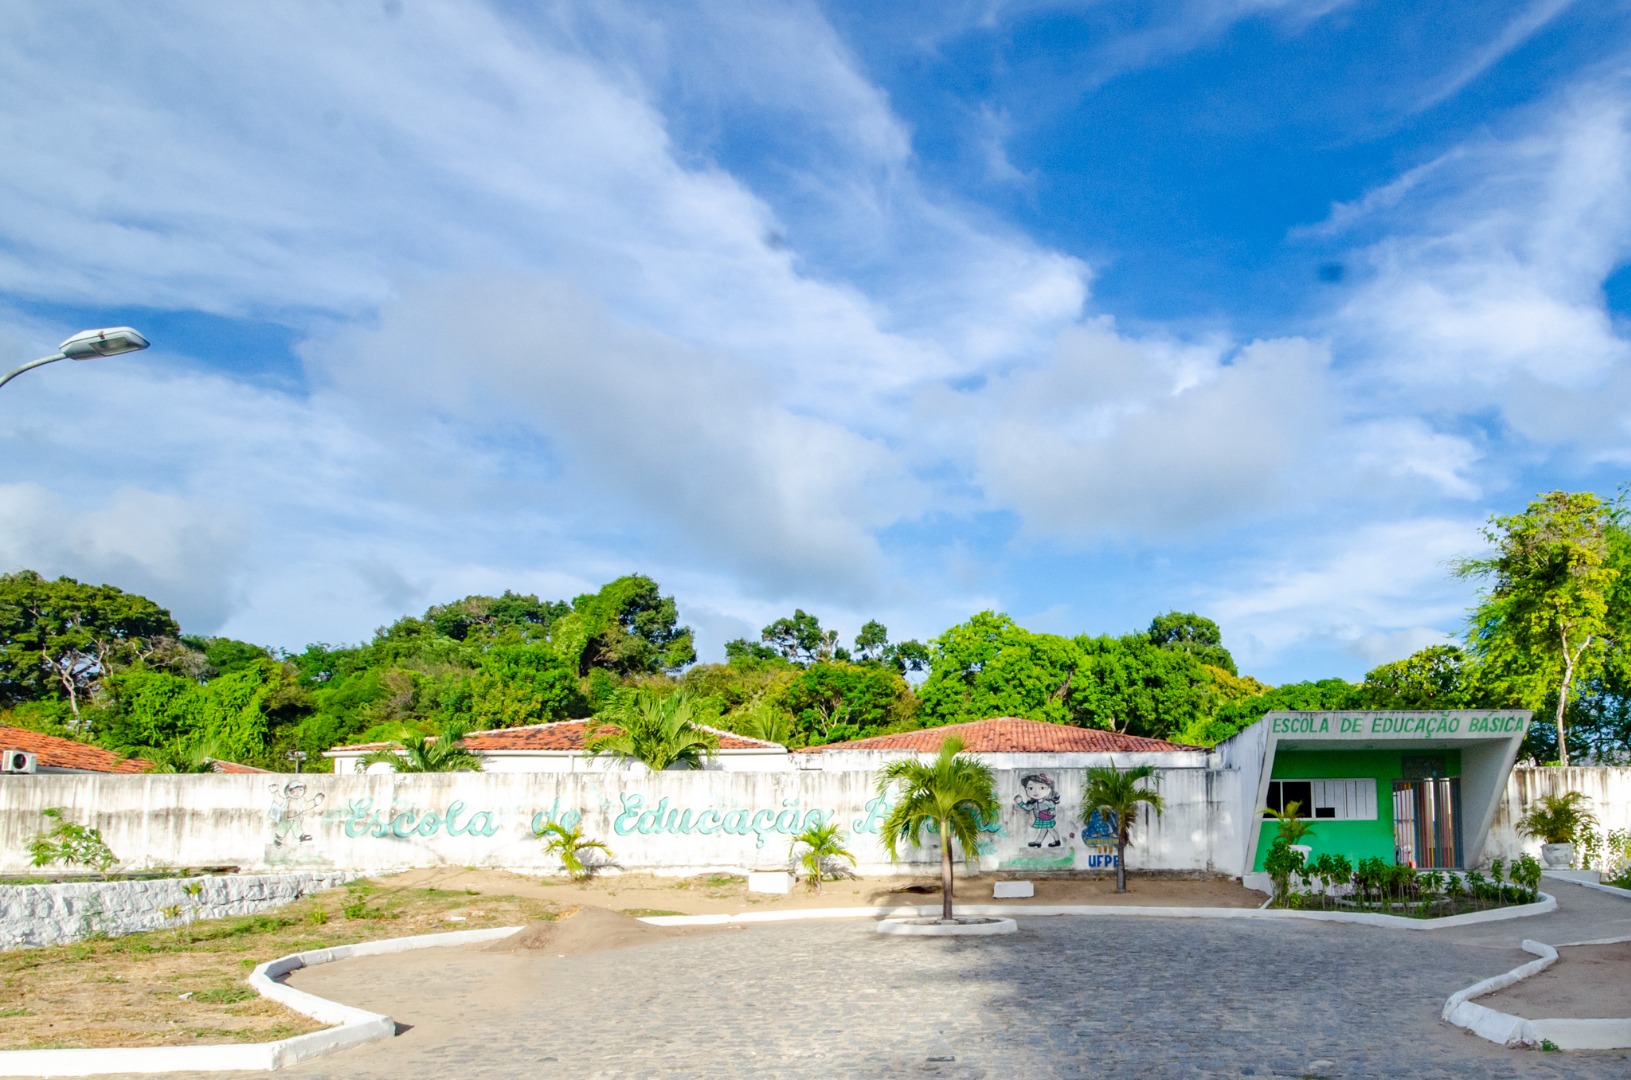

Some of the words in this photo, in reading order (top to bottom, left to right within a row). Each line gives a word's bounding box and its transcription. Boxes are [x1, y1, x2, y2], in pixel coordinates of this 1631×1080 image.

[1272, 717, 1329, 733] ESCOLA
[1340, 718, 1363, 733] DE
[1371, 711, 1460, 739] EDUCAÇÃO
[1468, 711, 1524, 733] BÁSICA
[344, 796, 500, 838] Escola
[531, 796, 582, 837] de
[613, 791, 835, 849] Educação
